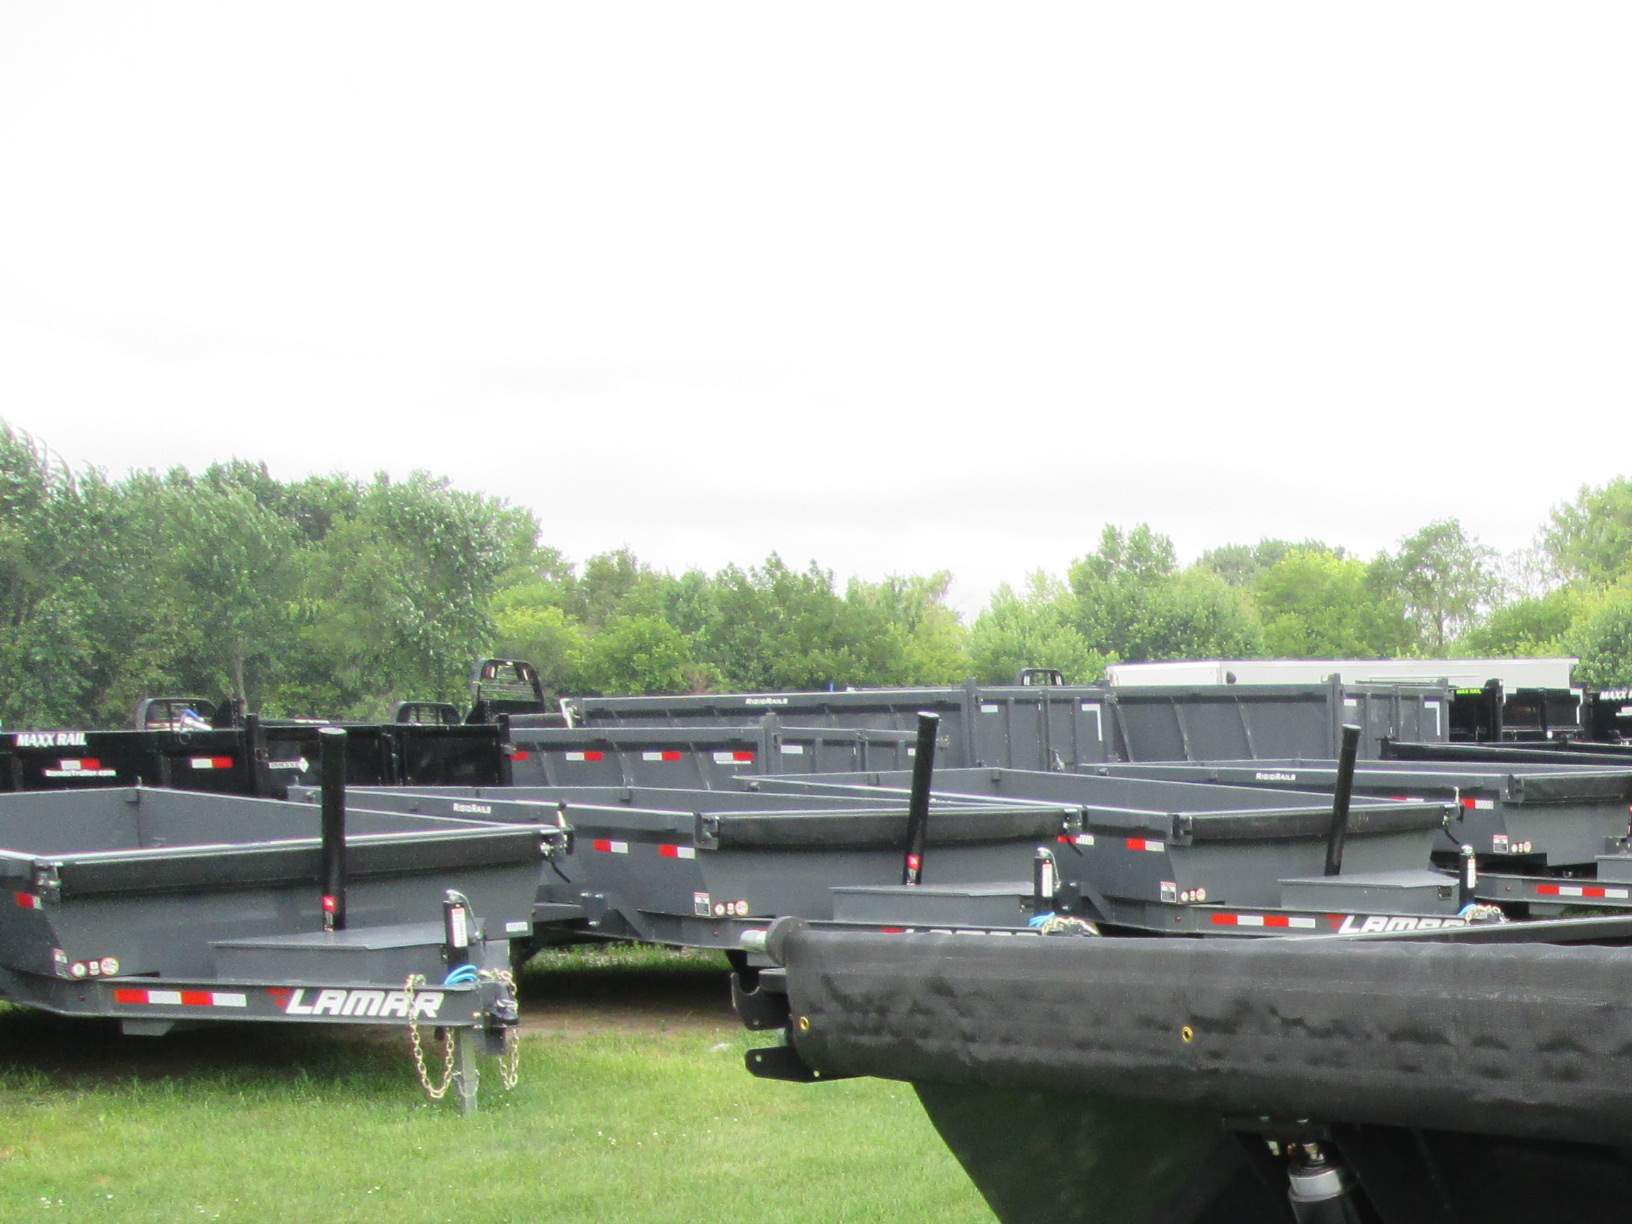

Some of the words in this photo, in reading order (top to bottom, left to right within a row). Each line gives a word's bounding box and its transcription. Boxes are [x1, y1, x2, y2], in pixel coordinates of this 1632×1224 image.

[1600, 690, 1627, 700] MAXX
[16, 733, 55, 748] MAXX
[56, 732, 88, 746] RAIL
[285, 988, 445, 1018] LAMAR
